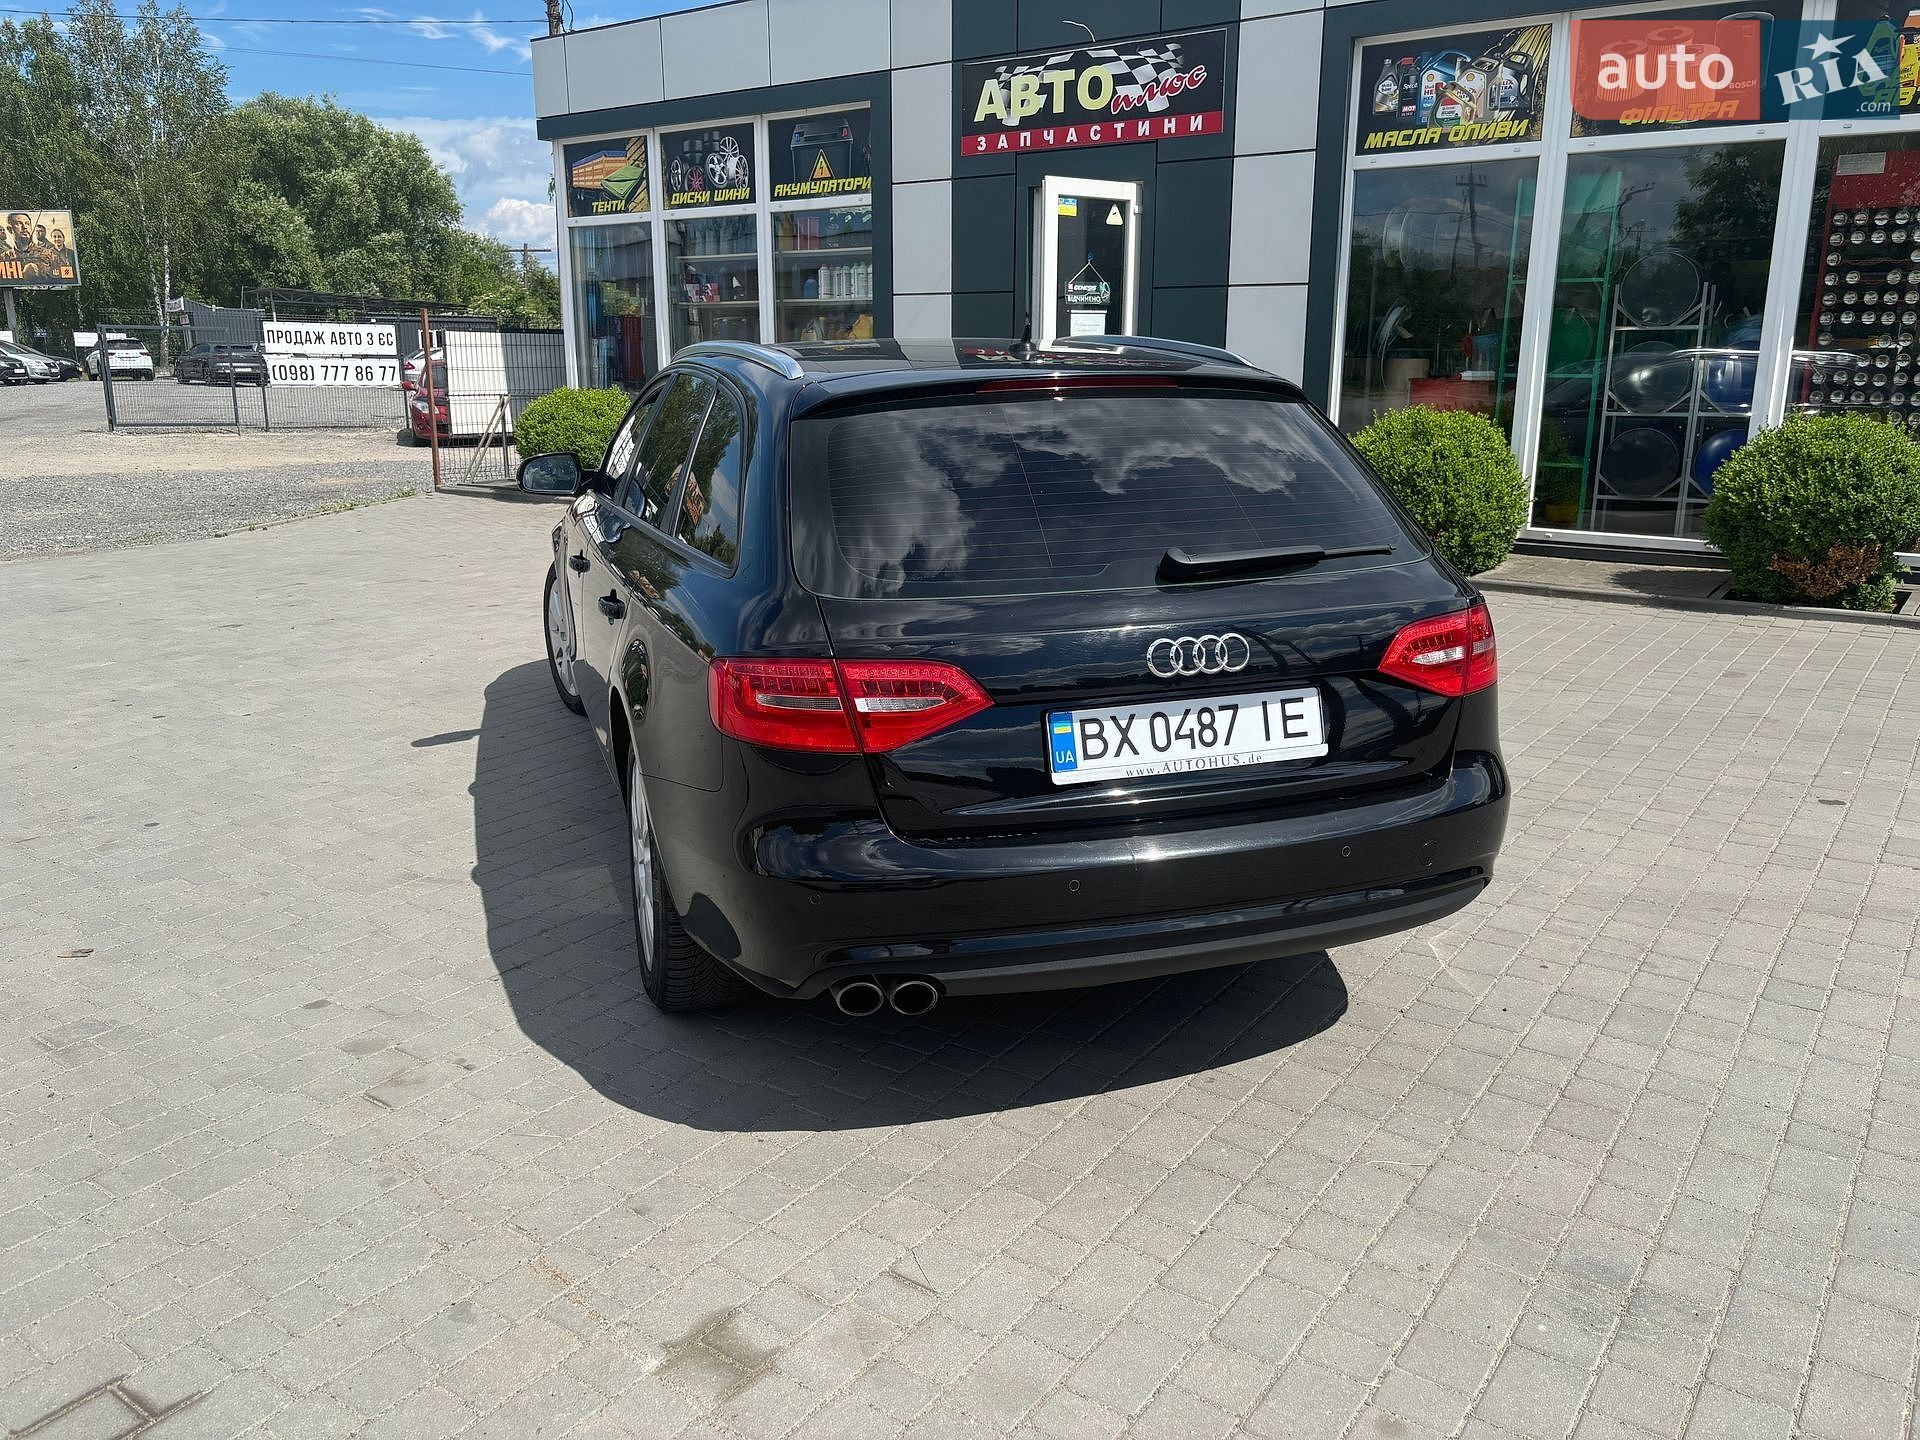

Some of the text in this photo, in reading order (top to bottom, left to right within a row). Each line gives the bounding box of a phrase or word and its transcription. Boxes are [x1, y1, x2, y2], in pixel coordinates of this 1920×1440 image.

[974, 64, 1207, 122] АВТО плюс
[1728, 79, 1758, 89] BOSCH
[1619, 100, 1739, 126] ФІЛЬТРА
[976, 114, 1204, 151] ЗАПЧАСТИНИ
[1364, 119, 1530, 149] МАСЛА ОЛИВИ
[670, 187, 751, 205] ДИСКИ ШИНИ
[774, 176, 872, 198] АКУМУЛЯТОРИ
[591, 200, 626, 213] ТЕНТИ
[266, 329, 326, 346] ПРОДАЖ
[330, 331, 363, 346] АВТО
[378, 332, 394, 346] ЄС
[271, 364, 397, 381] (098) 777 86 77
[1079, 697, 1309, 761] BX 0487 IE
[1055, 750, 1076, 764] UA
[1125, 753, 1263, 777] www.AUTOHUS.de
